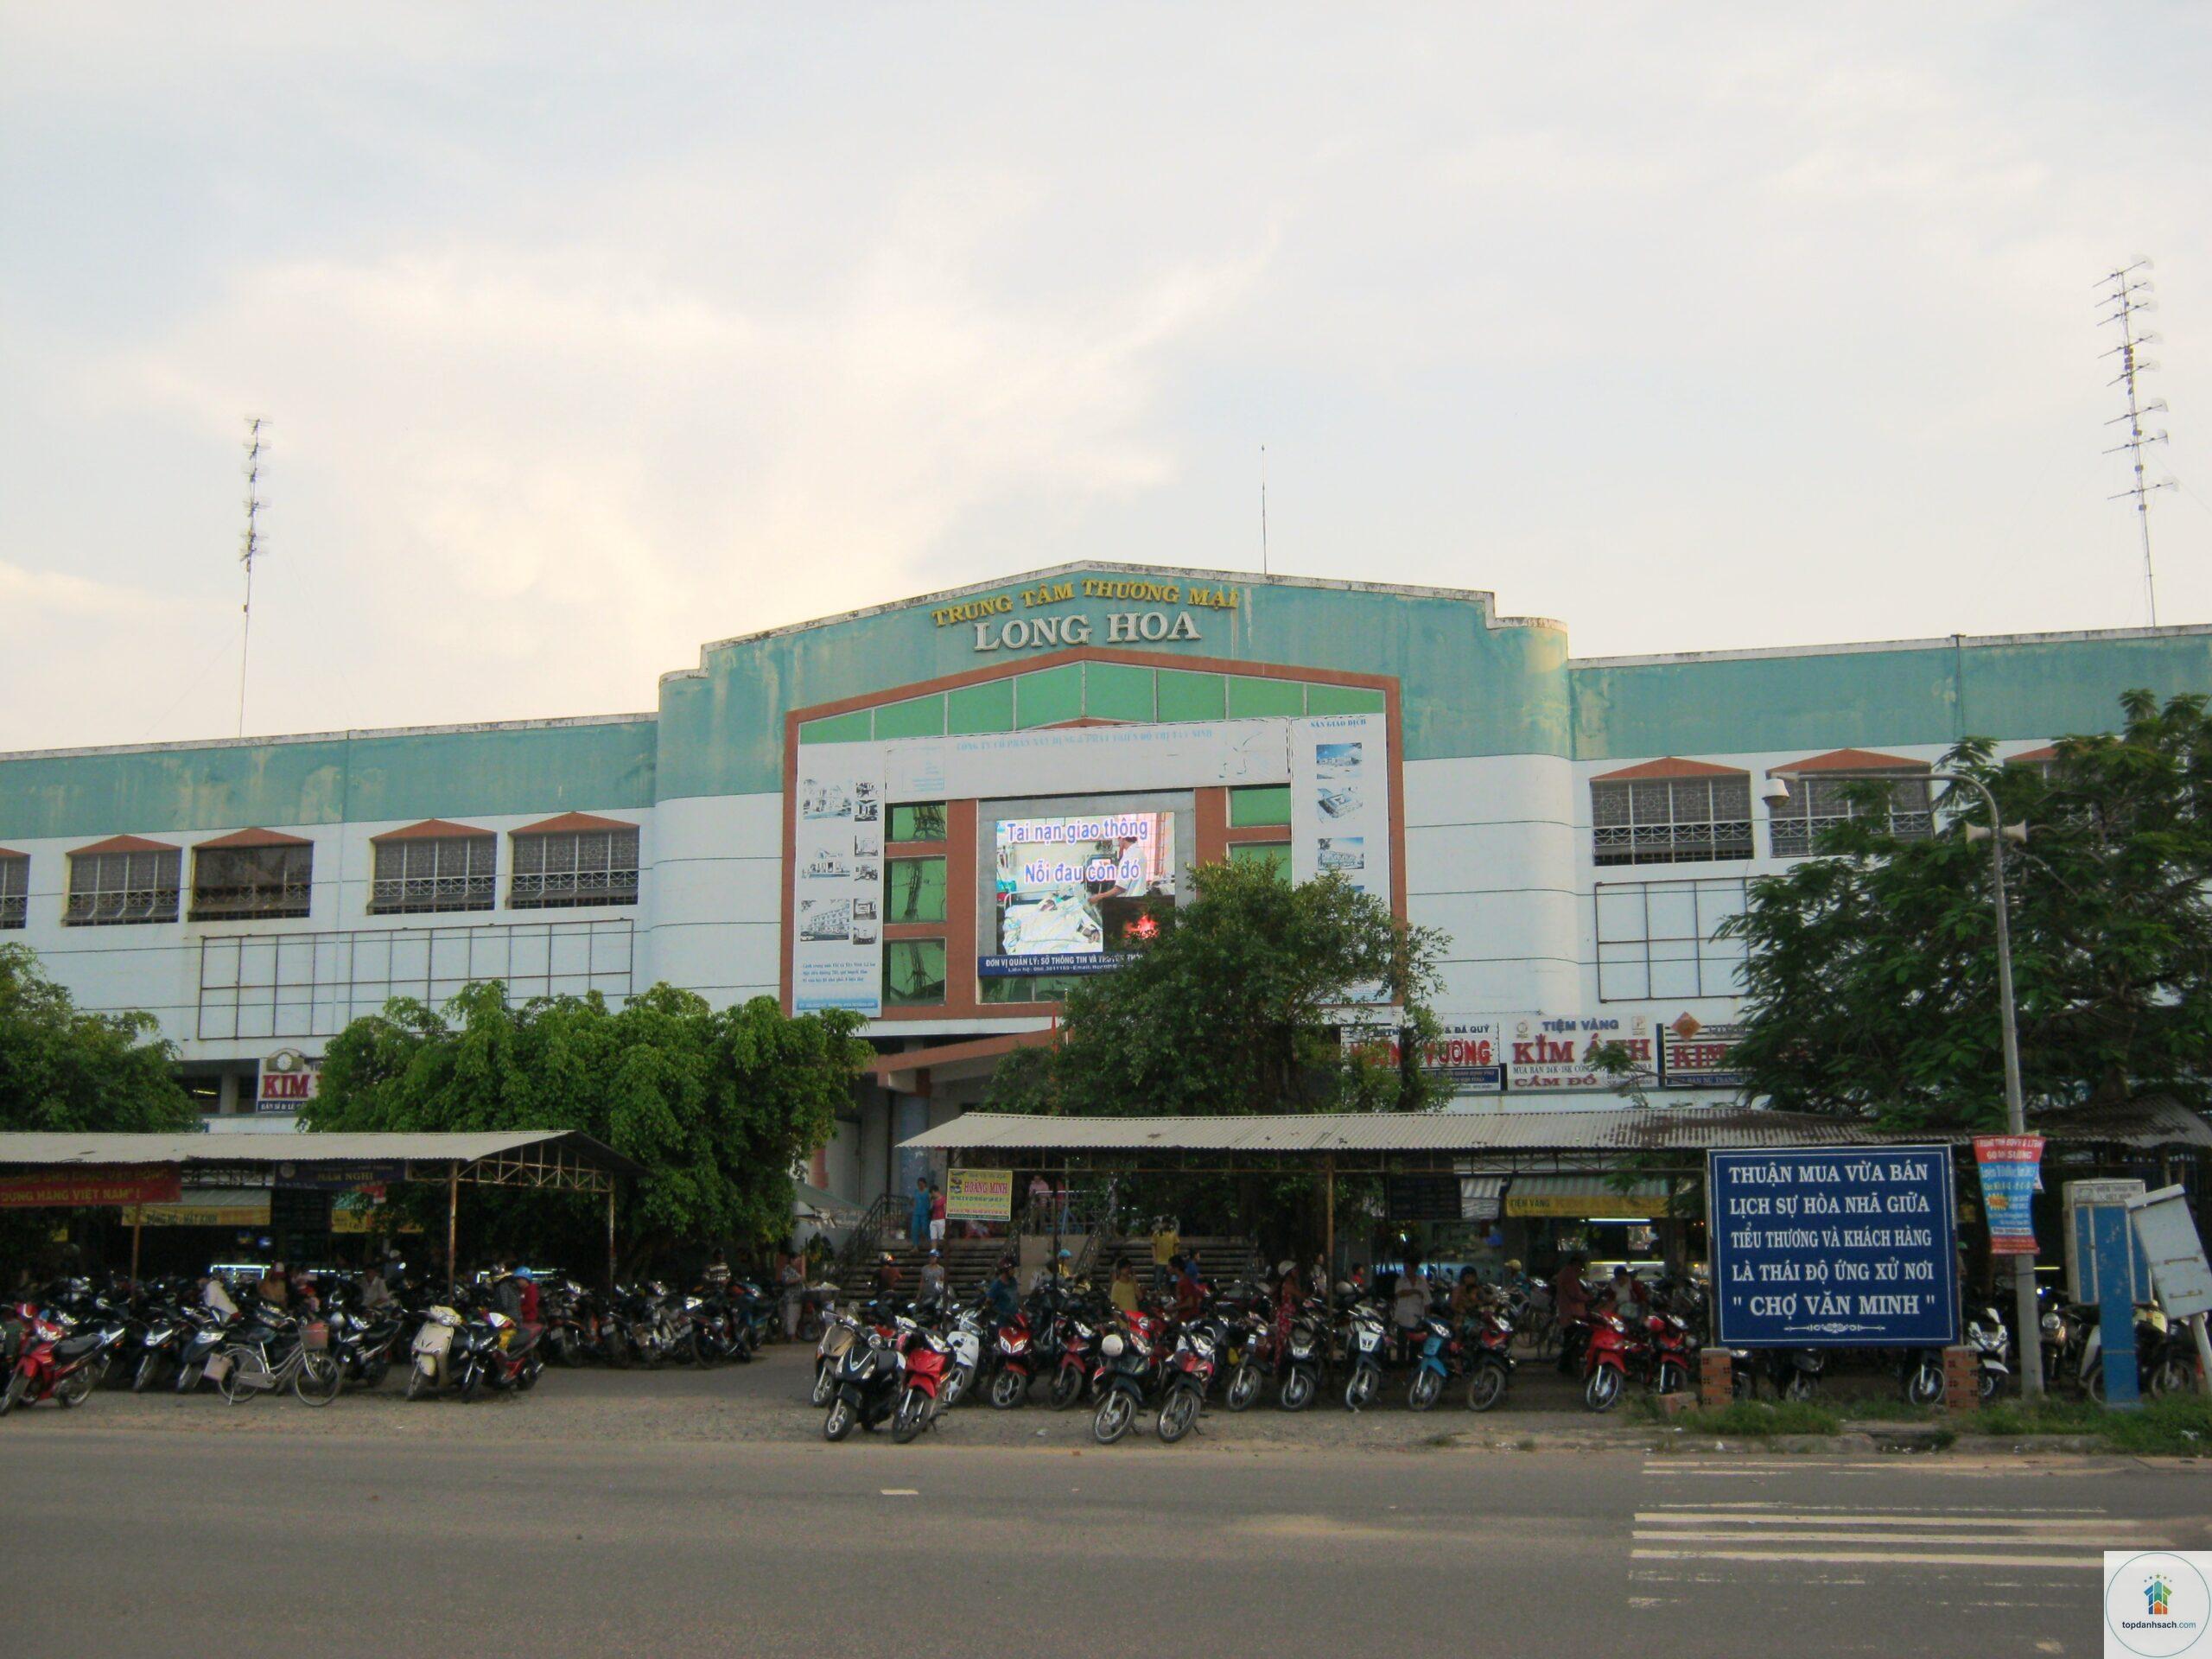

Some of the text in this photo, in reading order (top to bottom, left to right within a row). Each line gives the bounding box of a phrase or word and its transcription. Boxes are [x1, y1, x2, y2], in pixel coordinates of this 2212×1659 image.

[931, 578, 1238, 627] TRUNG TÂM THƯƠNG MẠI
[974, 610, 1202, 652] LONG HOA
[1007, 817, 1147, 846] Tai nạn giao thông
[1025, 859, 1050, 883] Nỗi
[1055, 862, 1083, 882] đau
[1121, 858, 1140, 880] đó
[986, 957, 1000, 967] ĐƠN
[1001, 958, 1007, 968] VỊ
[1008, 956, 1028, 967] QUẢN
[1052, 954, 1074, 964] THÔNG
[1076, 955, 1088, 964] TIN
[1089, 953, 1097, 963] VÀ
[1454, 1025, 1467, 1033] ĐÁ
[1470, 1025, 1490, 1034] QUÝ
[1541, 1018, 1619, 1033] TIỆM VÀNG
[1512, 1033, 1652, 1064] KIM ÁH
[1672, 1043, 1727, 1069] KIM
[262, 1074, 311, 1098] KIM
[1728, 1160, 1929, 1186] THUẬN MUA VỪA BÁN
[73, 1187, 99, 1202] VIỆT
[989, 1182, 1007, 1194] MINH
[1730, 1192, 1930, 1218] LỊCH SỰ HÒA NHÃ GIỮA
[1731, 1222, 1932, 1248] TIỂU THƯƠNG VÀ KHÁCH HÀNG
[1732, 1256, 1935, 1285] LÀ THÁI ĐỘ ỨNG XỬ NƠI
[1750, 1293, 1797, 1319] CHỢ
[1804, 1291, 1851, 1315] VĂN
[1859, 1295, 1920, 1315] MINH
